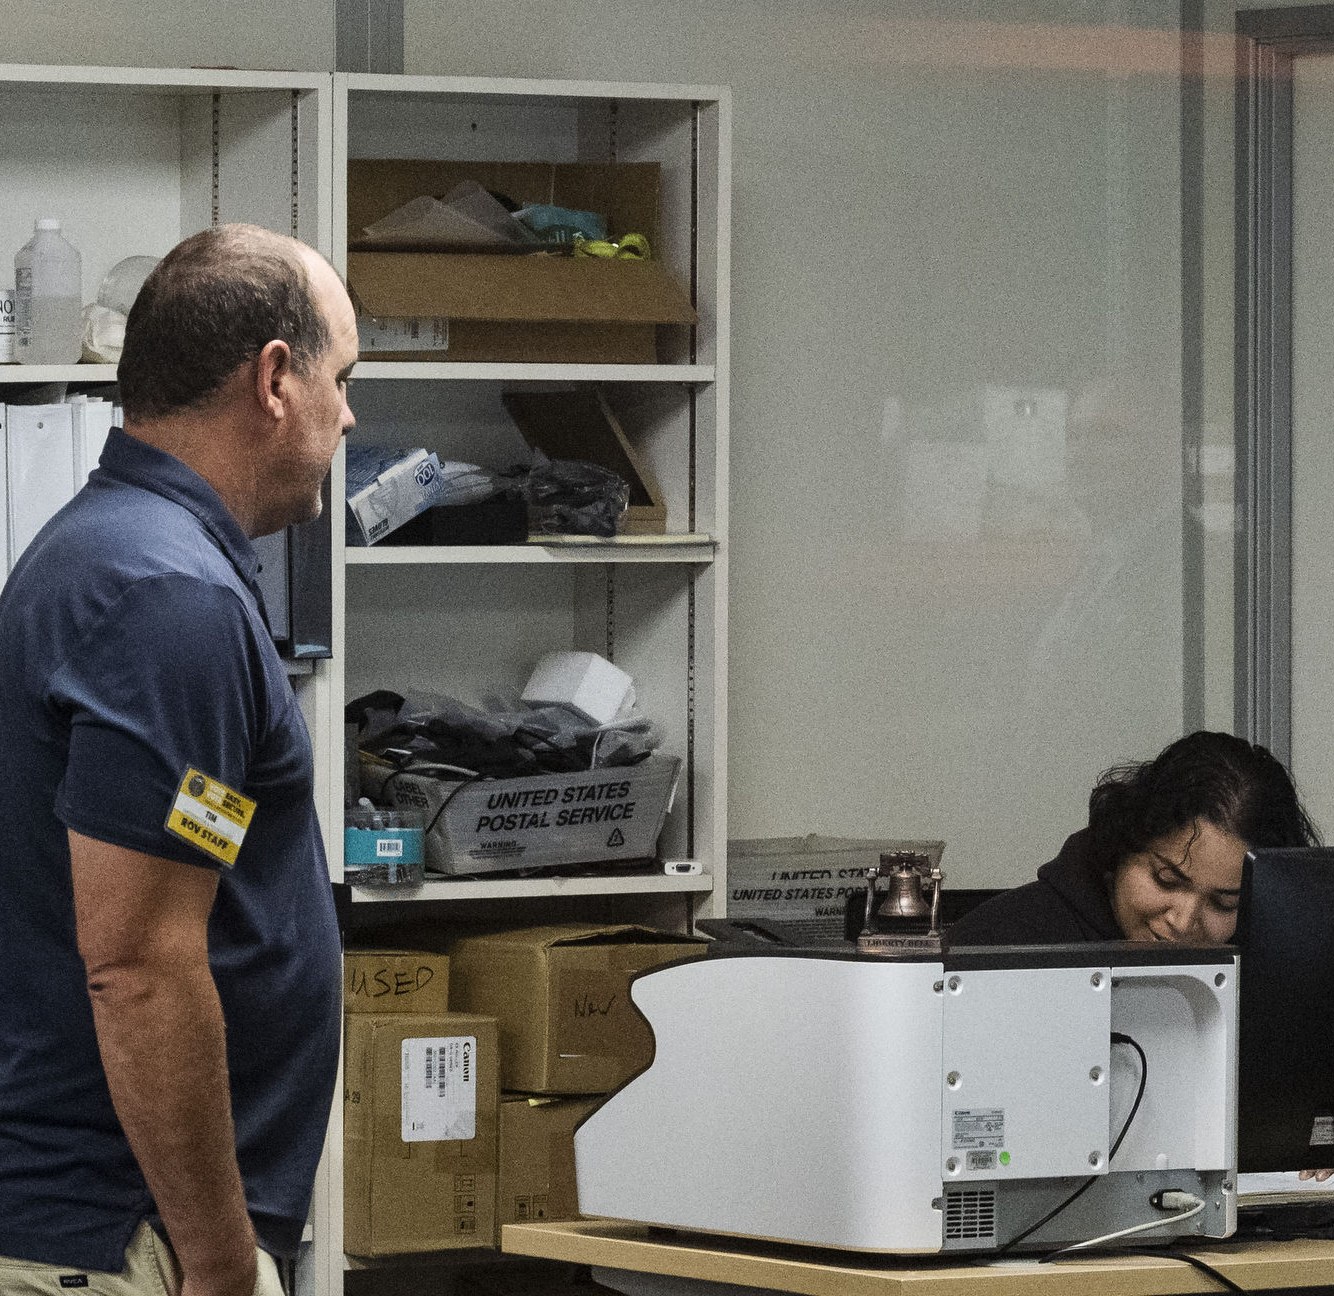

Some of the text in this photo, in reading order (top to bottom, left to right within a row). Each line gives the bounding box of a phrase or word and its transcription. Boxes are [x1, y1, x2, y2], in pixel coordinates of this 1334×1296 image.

[417, 463, 435, 485] 100
[487, 781, 632, 810] UNITED STATES
[476, 802, 636, 833] POSTAL SERVICE
[180, 817, 201, 835] ROV
[201, 831, 229, 850] STAFF
[480, 840, 517, 849] WARNING
[732, 888, 782, 901] UNITED
[784, 886, 834, 899] STATES
[907, 939, 929, 947] BELL
[352, 966, 434, 998] USED
[462, 1041, 472, 1082] Canon
